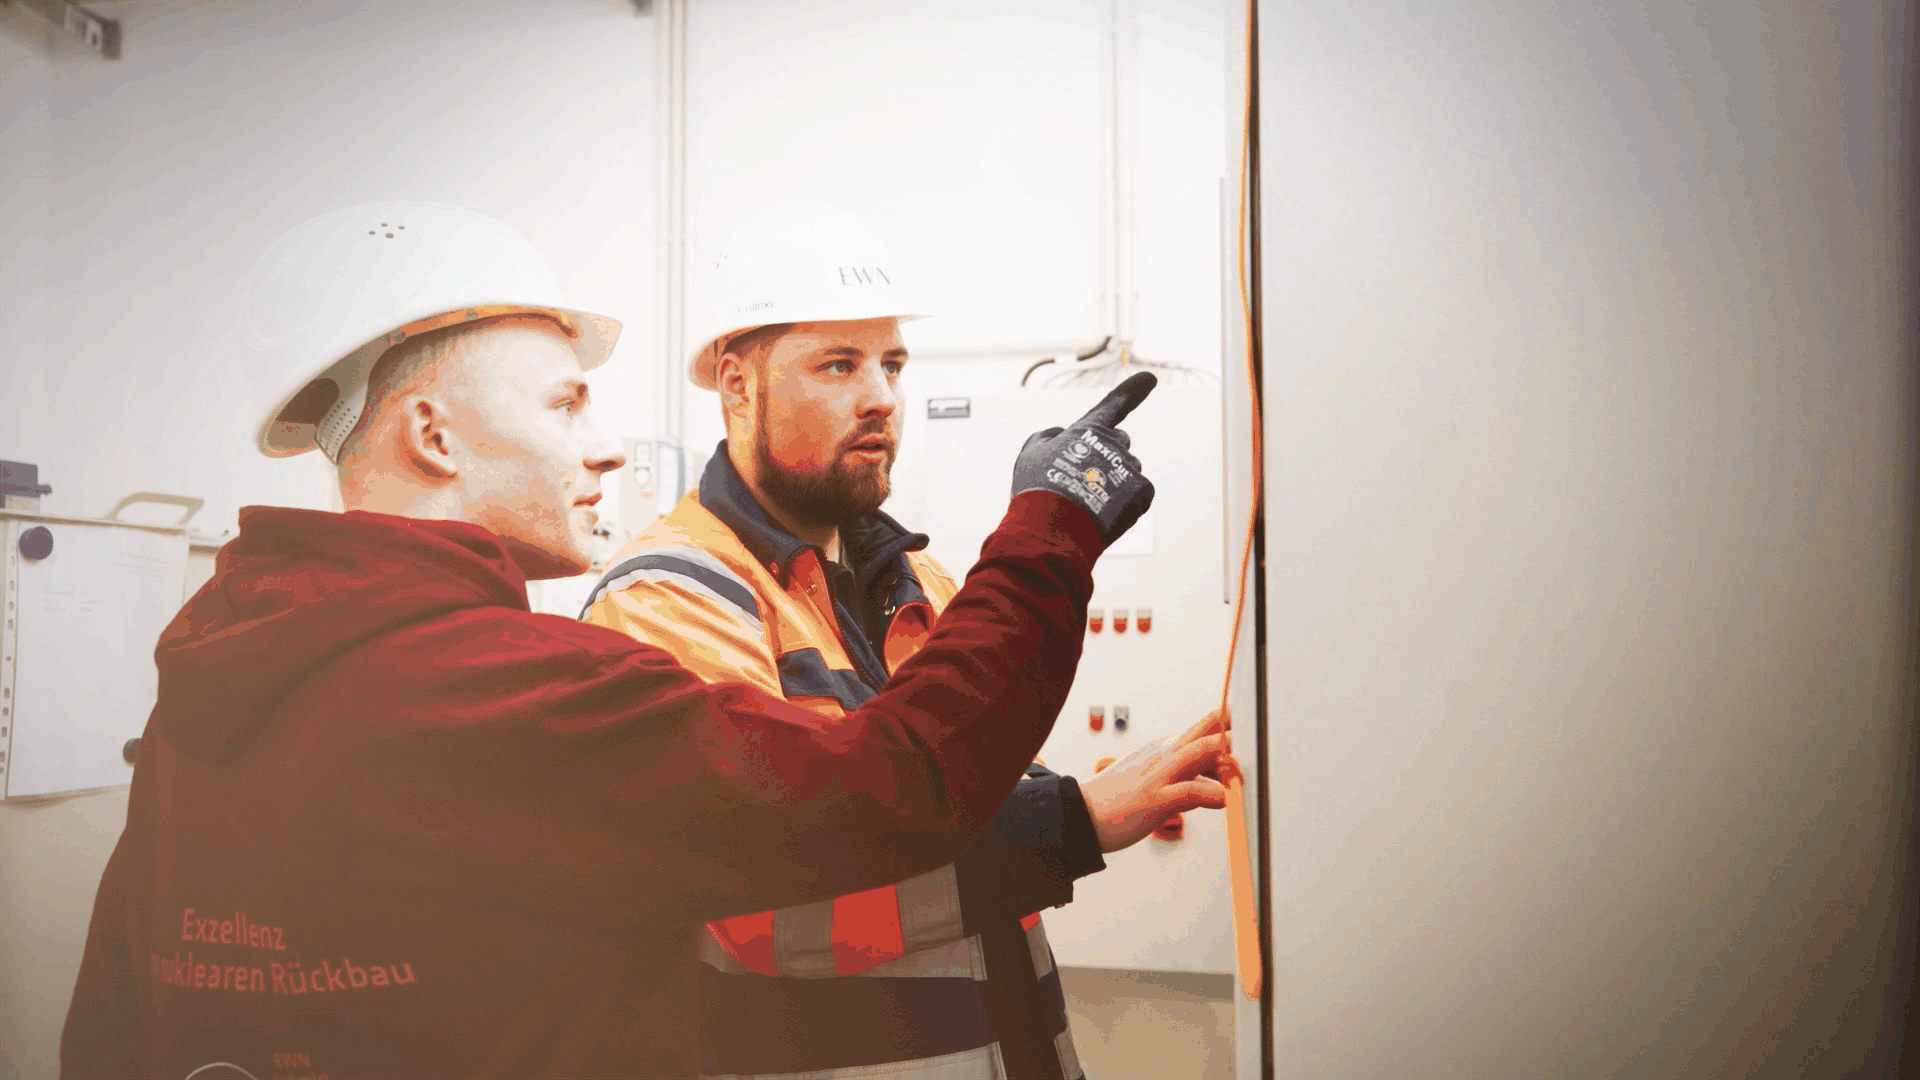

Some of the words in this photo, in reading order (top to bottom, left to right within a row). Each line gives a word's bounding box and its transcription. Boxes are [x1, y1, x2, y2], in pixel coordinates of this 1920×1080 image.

[839, 265, 891, 286] EWN
[1080, 429, 1131, 479] MaxiCut
[181, 908, 287, 951] Exzellenz
[269, 957, 416, 994] Rückbau
[273, 1052, 311, 1069] EWN
